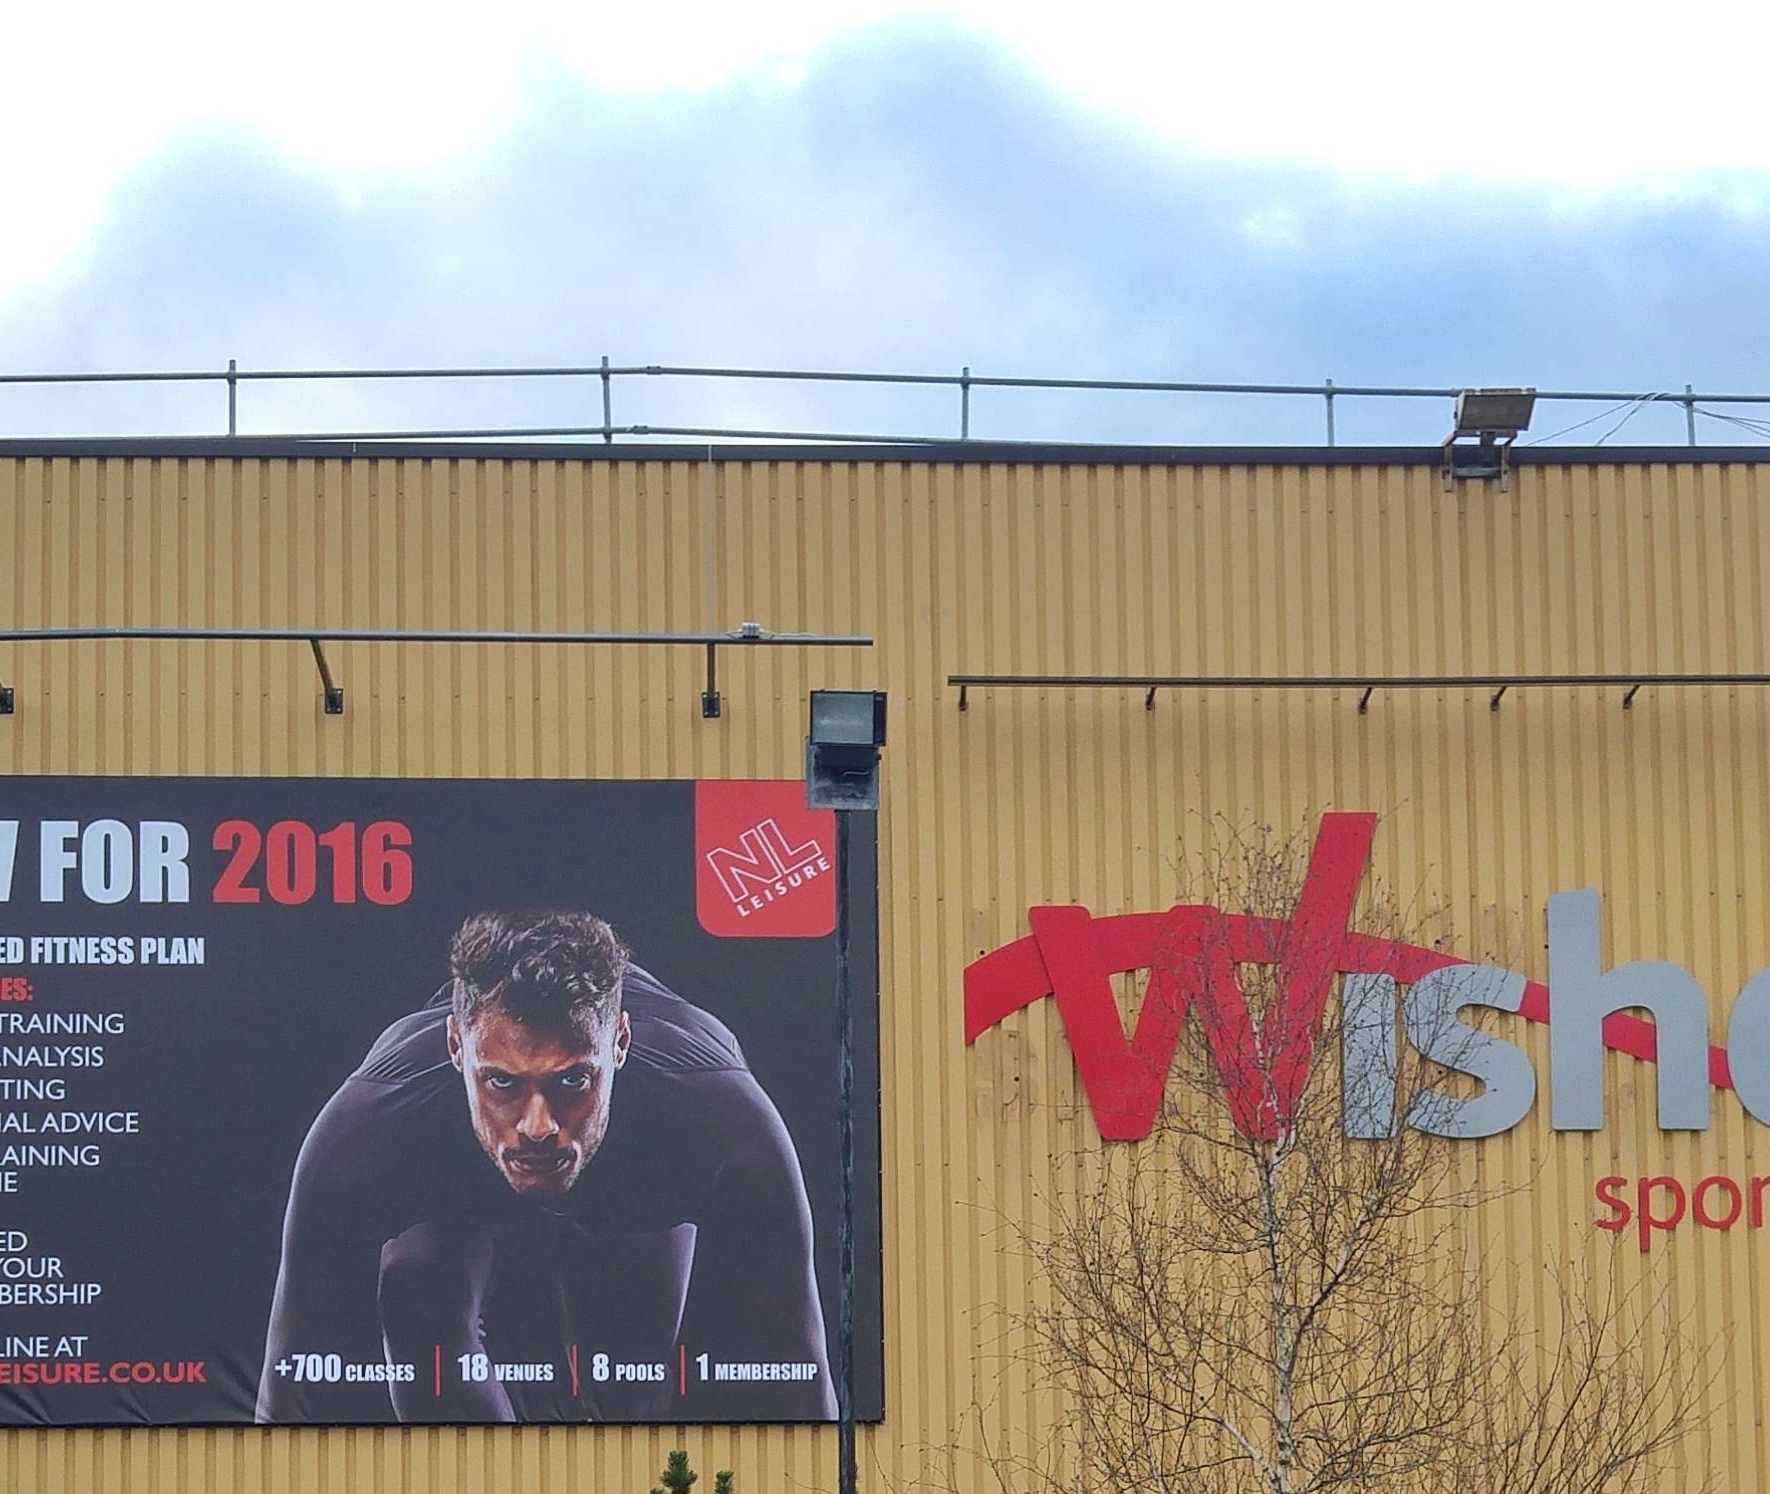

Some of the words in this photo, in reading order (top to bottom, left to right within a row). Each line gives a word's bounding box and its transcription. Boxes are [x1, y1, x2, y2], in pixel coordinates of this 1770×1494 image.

[40, 819, 191, 904] FOR
[213, 821, 413, 905] 2016
[706, 818, 822, 903] NL
[737, 857, 831, 917] LEISURE
[30, 936, 135, 966] FITNESS
[140, 936, 206, 966] PLAN
[41, 1112, 140, 1135] ADVICE
[54, 1337, 89, 1359] AT
[275, 1353, 343, 1382] +700
[345, 1364, 416, 1382] CLASSES
[458, 1353, 489, 1382] 18
[494, 1363, 554, 1382] VENUES
[592, 1353, 610, 1382] 8
[615, 1363, 665, 1381] POOLS
[695, 1353, 709, 1381] 1
[715, 1363, 818, 1381] MEMBERSHIP
